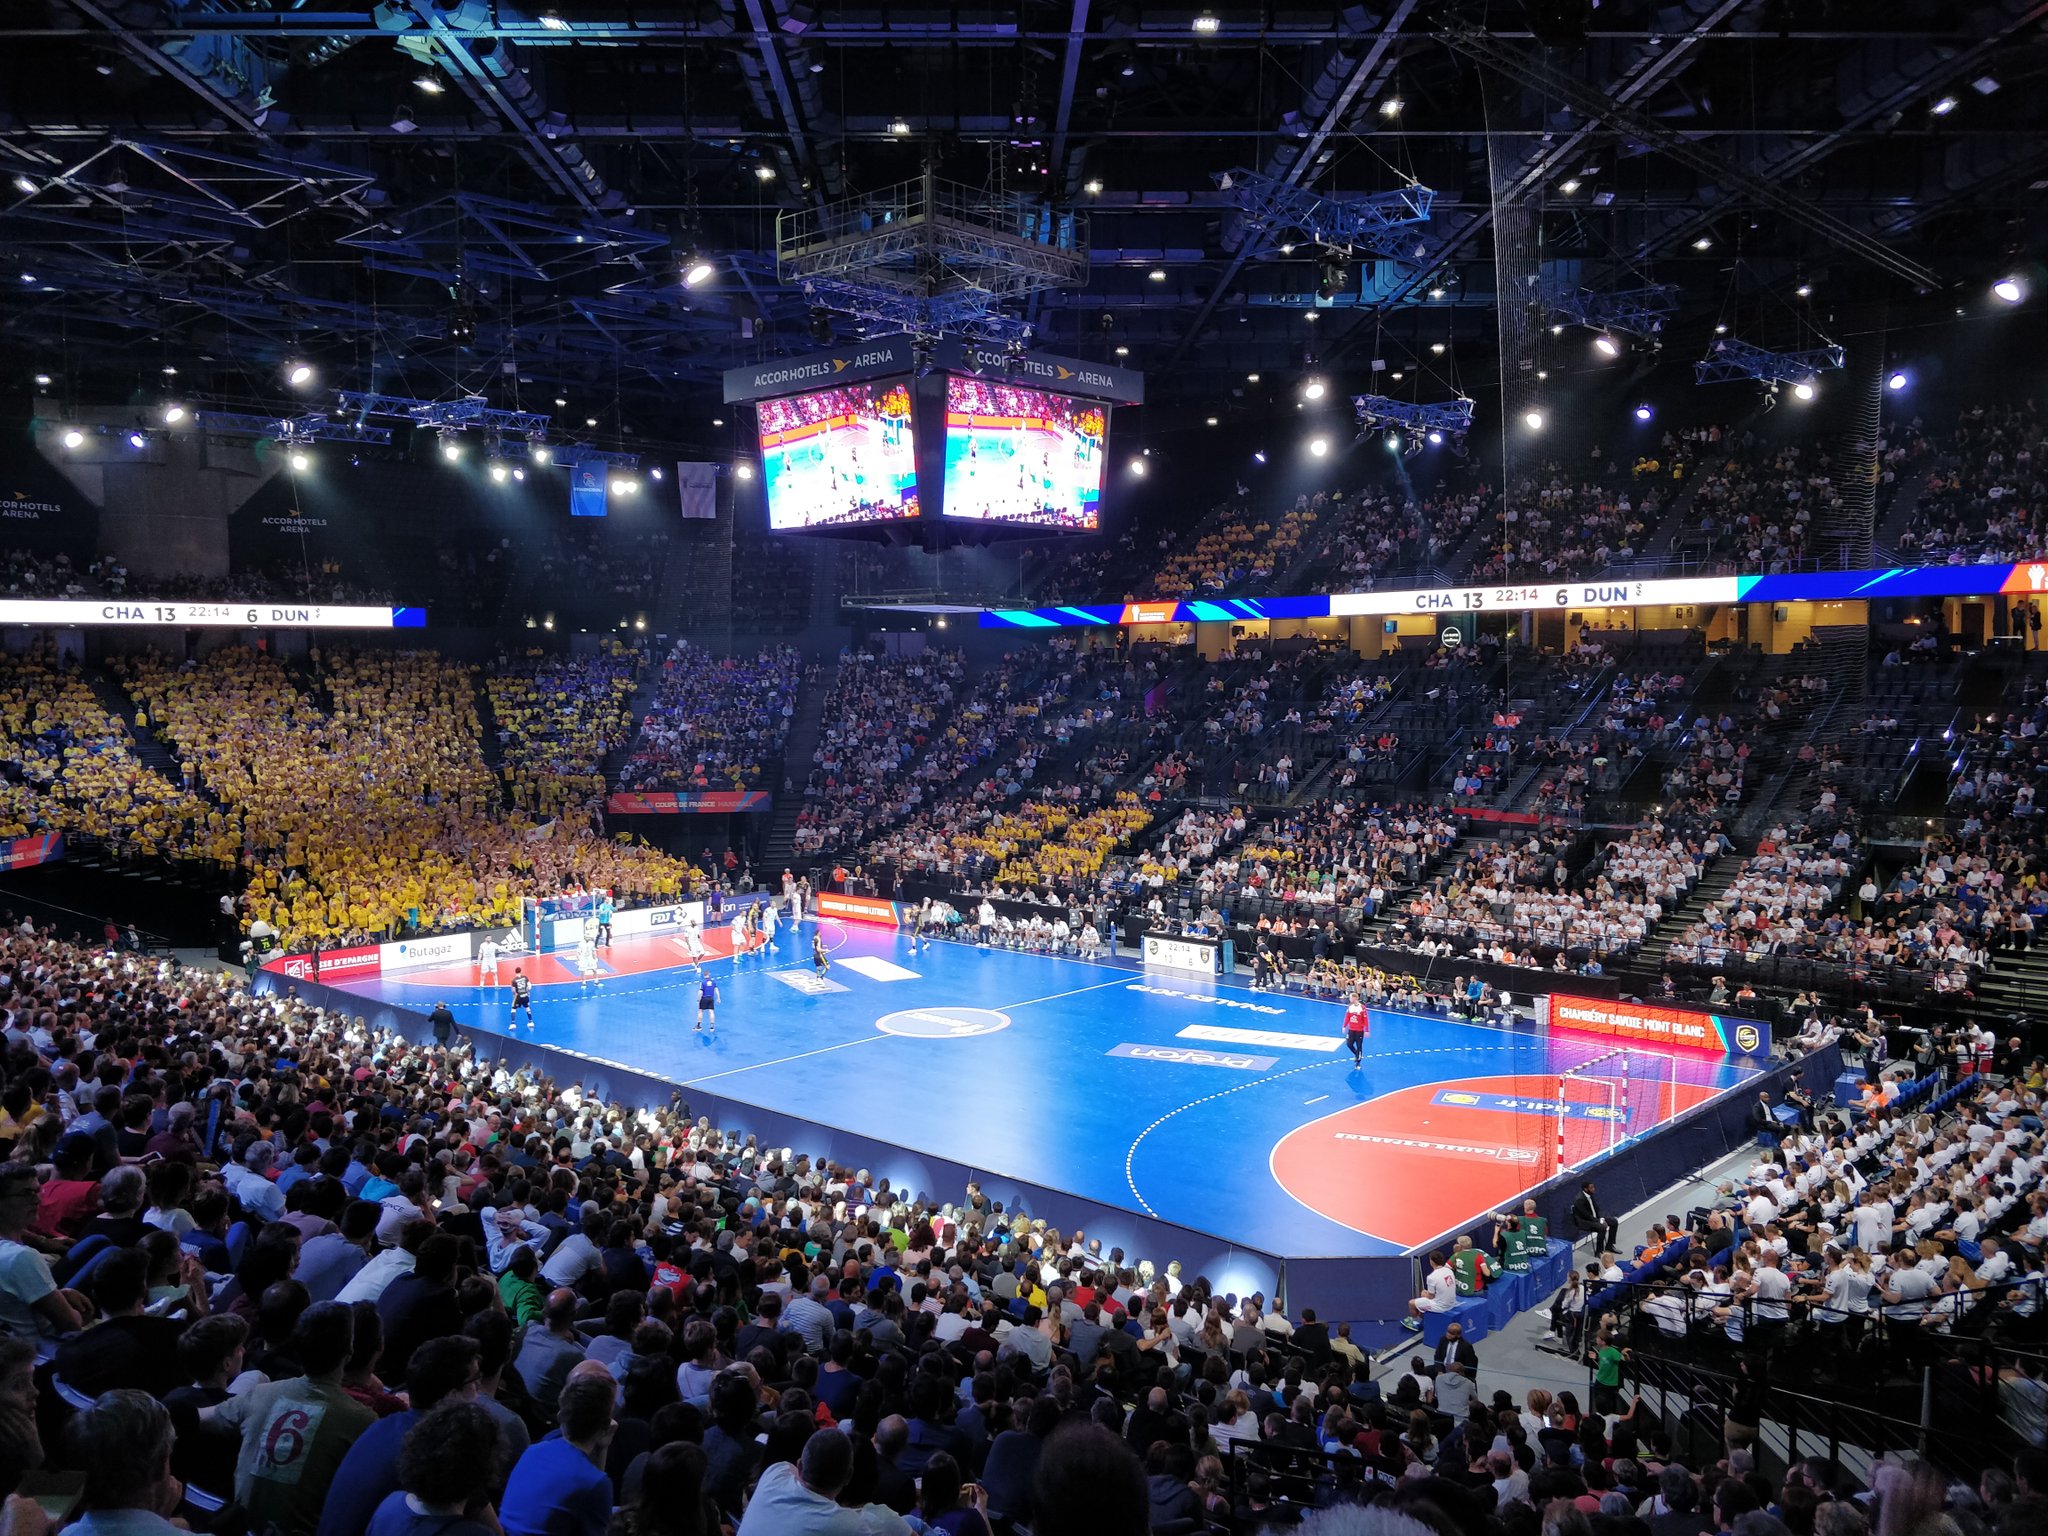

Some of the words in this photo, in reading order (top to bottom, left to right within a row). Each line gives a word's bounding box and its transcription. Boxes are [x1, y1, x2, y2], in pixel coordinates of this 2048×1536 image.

[754, 361, 830, 387] ACCORHOTELS
[854, 349, 893, 369] ARENA
[1078, 371, 1114, 388] ARENA
[2, 509, 40, 519] ARENA
[262, 517, 327, 526] ACCORHOTELS
[280, 525, 310, 533] ARENA
[1416, 594, 1453, 609] CHA
[1463, 592, 1483, 609] 13
[1495, 588, 1538, 602] 22:14
[1556, 588, 1568, 606] 6
[1584, 586, 1627, 603] DUN
[102, 606, 145, 620] CHA
[154, 607, 176, 622] 13
[188, 606, 230, 617] 22:14
[247, 609, 258, 623] 6
[271, 609, 309, 622] DUN
[651, 911, 671, 924] FDJ
[409, 945, 452, 958] Butagaz
[1168, 943, 1191, 952] 22:14
[1559, 1006, 1608, 1024] CHAMBÉRY
[1608, 1013, 1643, 1029] SAVOIE
[1644, 1018, 1672, 1033] MONT
[1672, 1022, 1705, 1038] BLANC
[266, 1409, 310, 1466] 6
